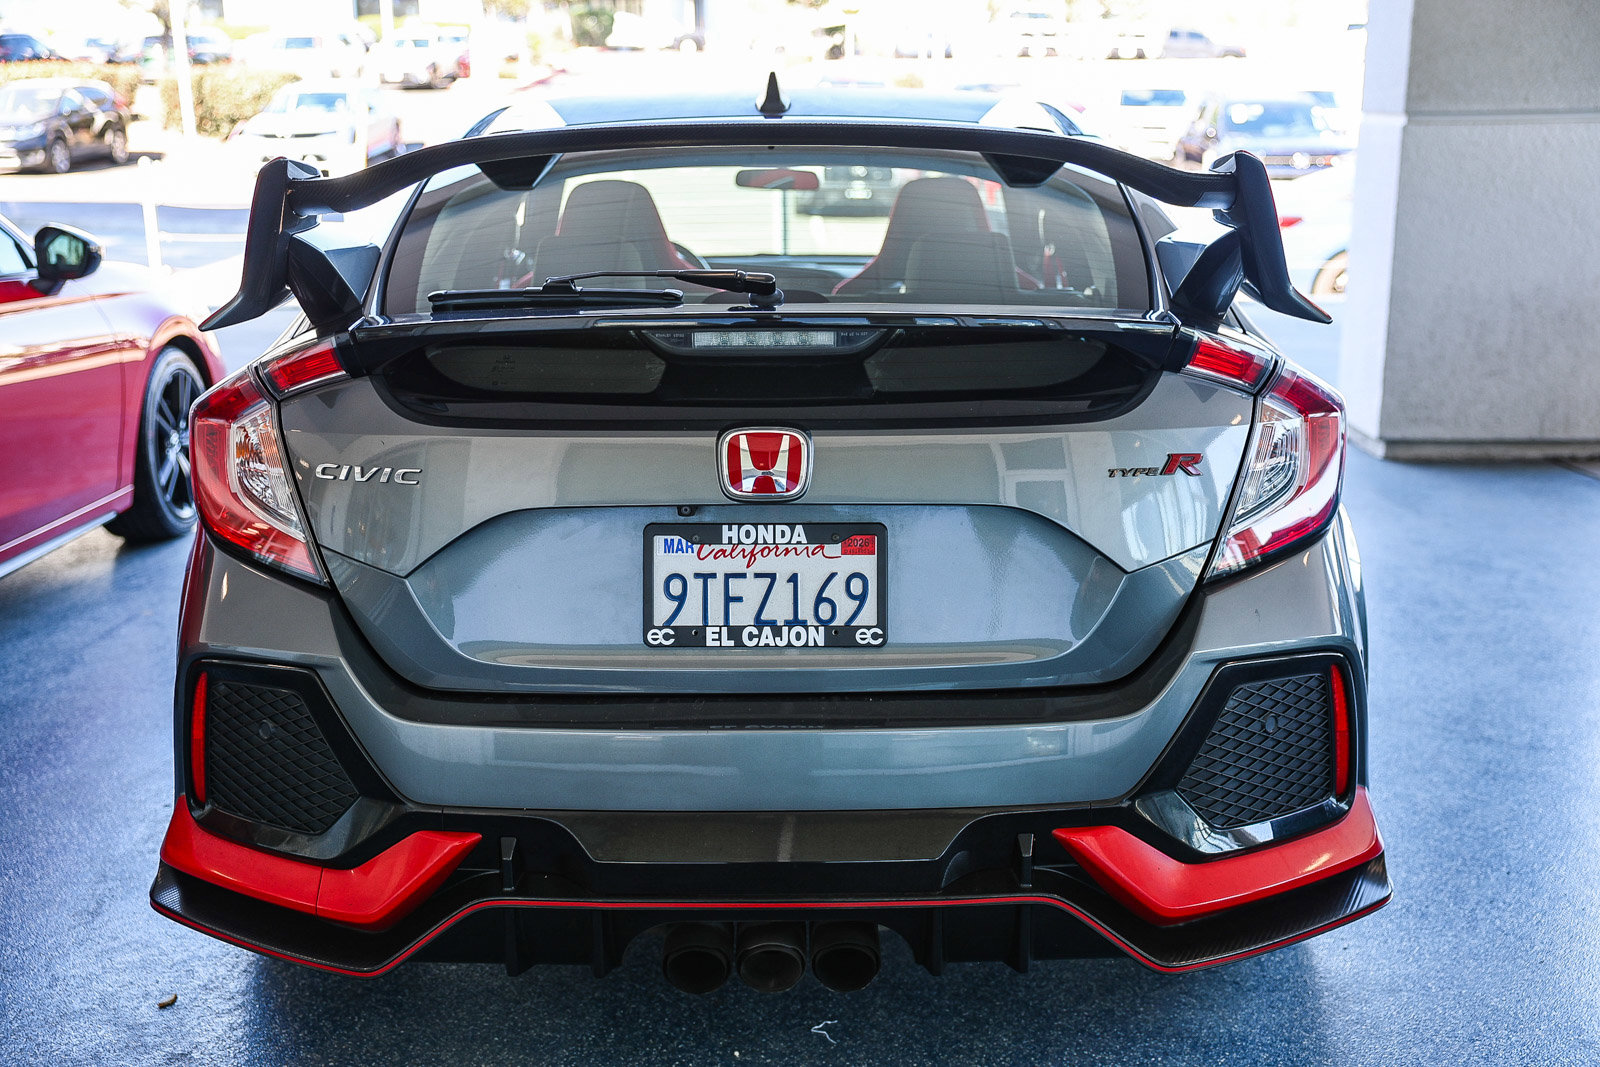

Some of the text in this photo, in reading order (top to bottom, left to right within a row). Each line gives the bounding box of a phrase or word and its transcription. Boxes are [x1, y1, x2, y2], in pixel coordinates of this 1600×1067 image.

[315, 463, 422, 485] CIVIC
[1108, 453, 1203, 478] TYPE R
[722, 524, 807, 544] HONDA
[847, 538, 870, 547] 2026
[663, 538, 695, 553] MAR
[697, 544, 842, 568] California
[662, 572, 870, 626] 9TFZ169
[705, 625, 825, 647] EL CAJON
